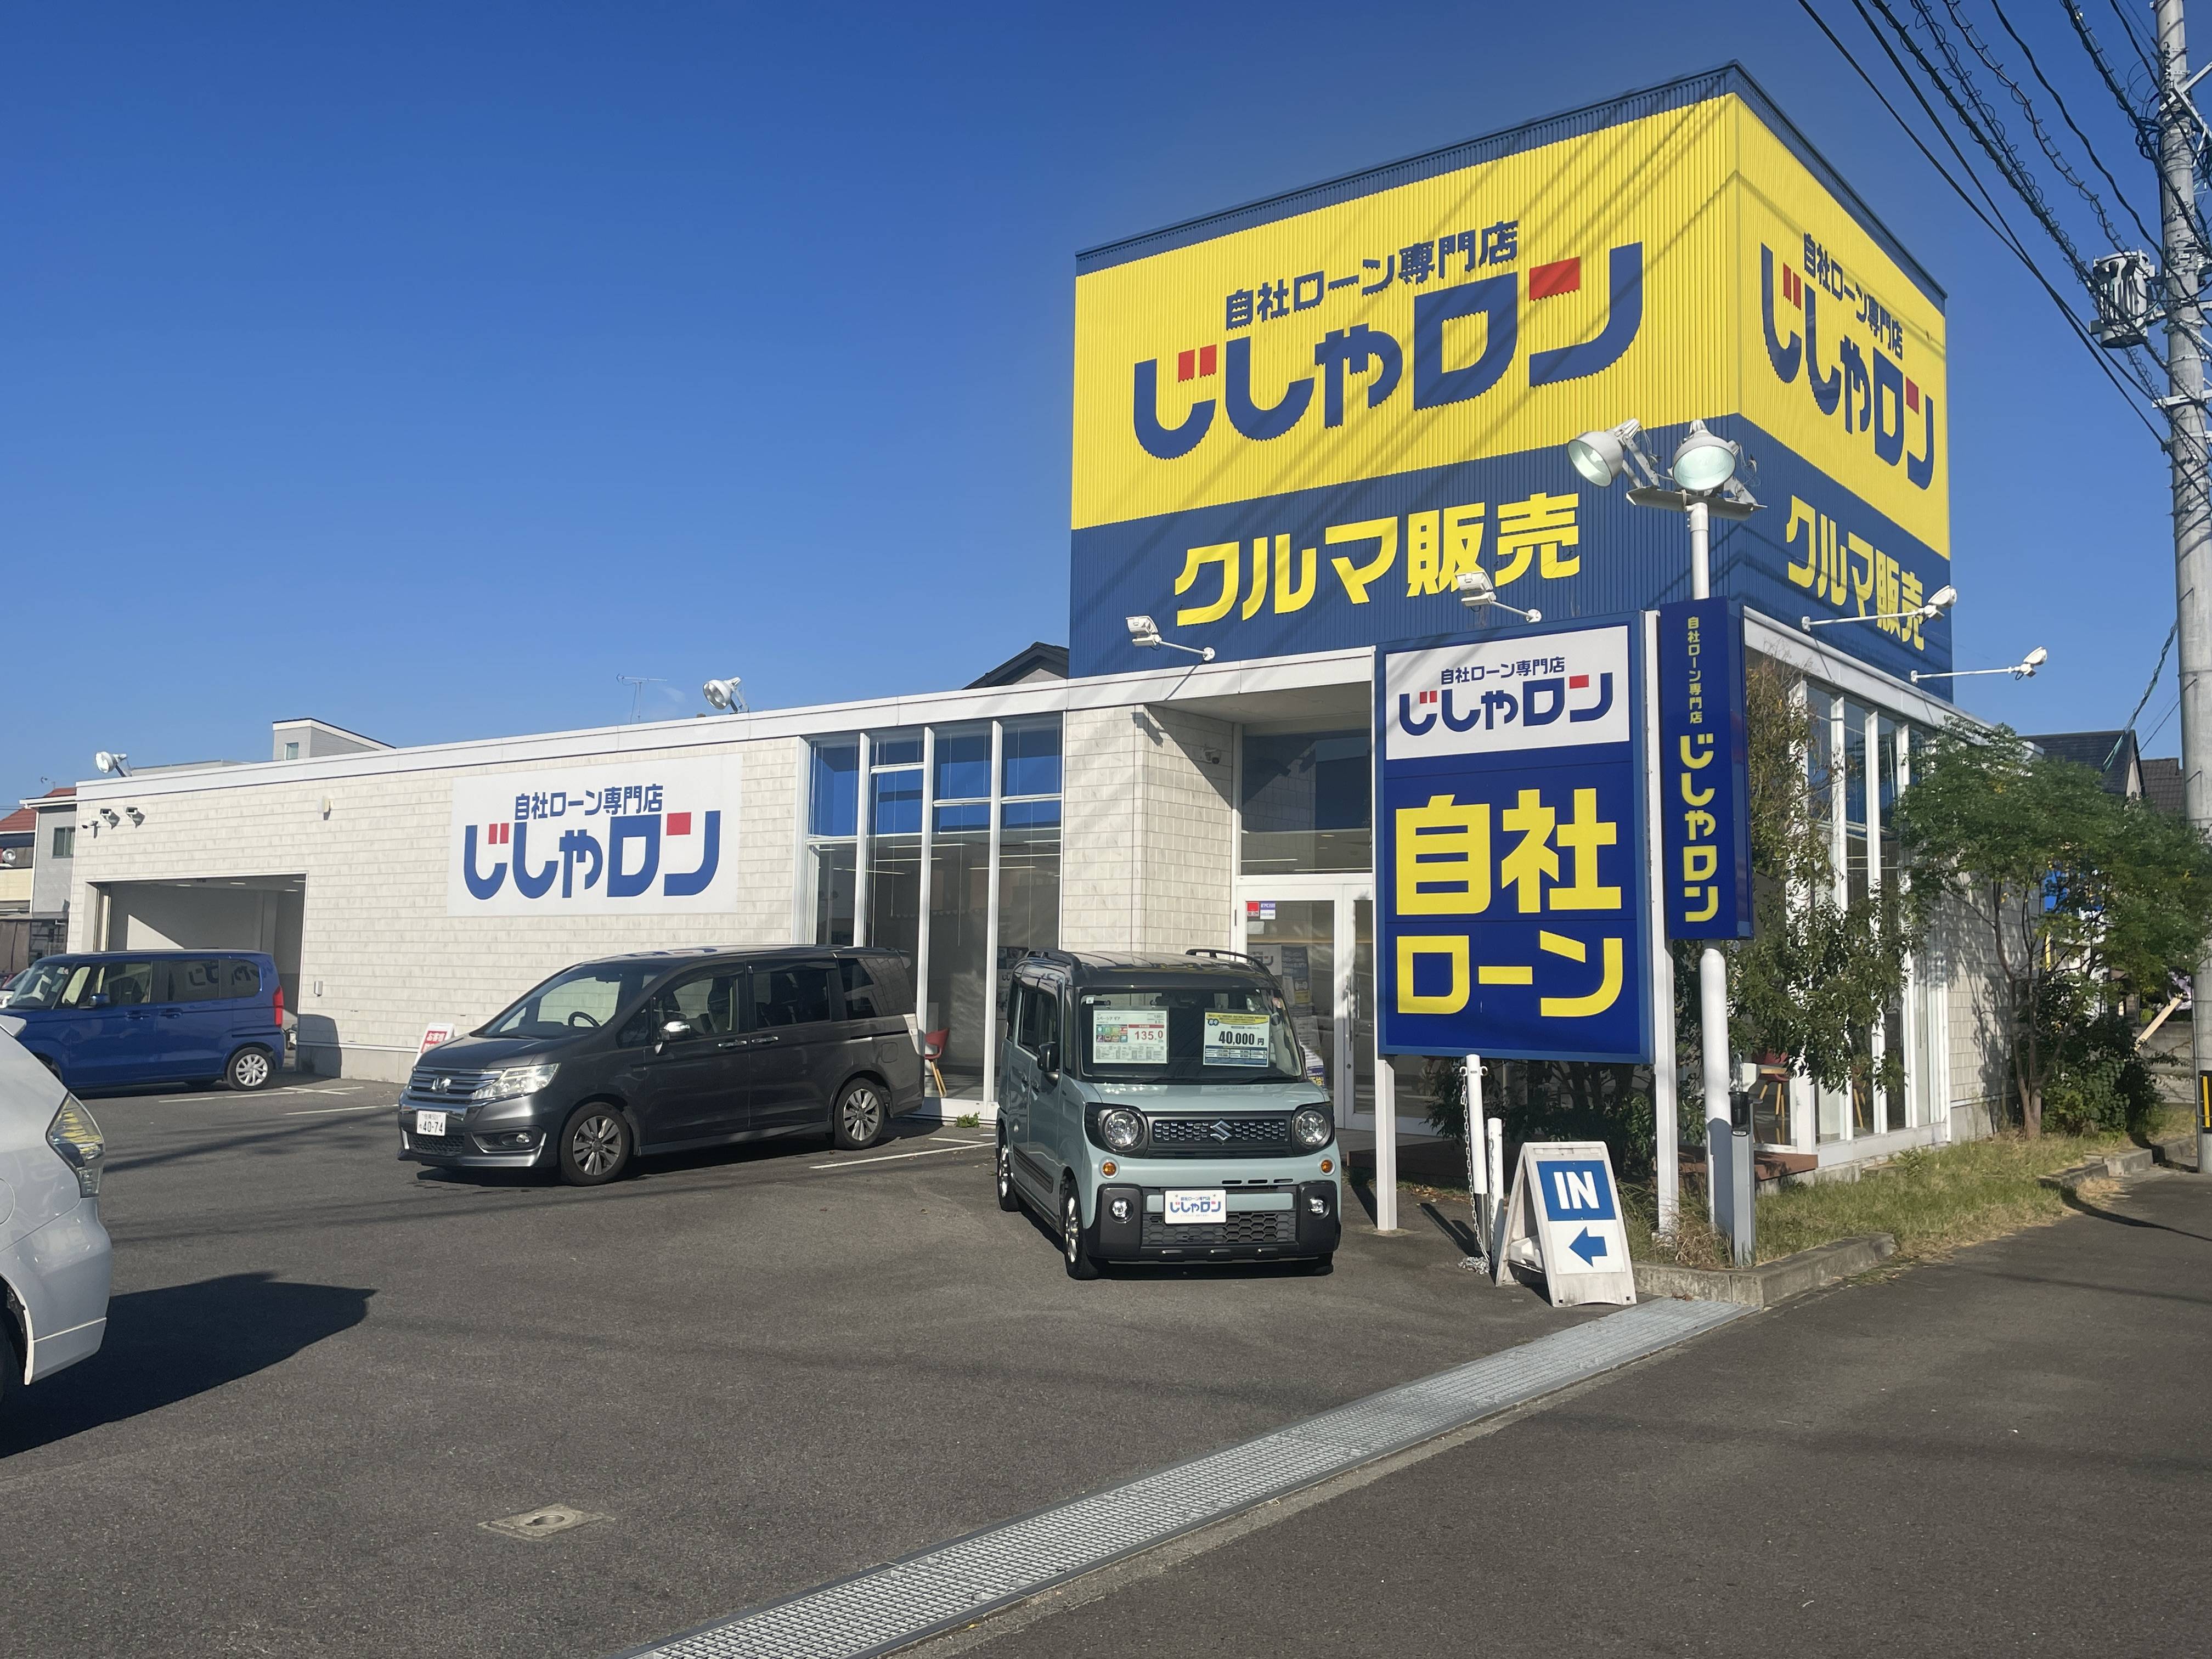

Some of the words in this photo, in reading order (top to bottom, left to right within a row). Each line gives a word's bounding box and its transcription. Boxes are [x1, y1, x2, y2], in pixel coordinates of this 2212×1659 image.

[1226, 221, 1518, 330] 自社ローン専門店
[1803, 233, 1903, 360] 自社ローン専門店
[1133, 241, 1643, 460] じしゃロン
[1761, 242, 1934, 490] じしゃロン
[1175, 493, 1579, 626] クルマ販売
[1786, 494, 1925, 651] クルマ販売
[1399, 672, 1613, 736] じしゃロン
[1441, 656, 1565, 685] 自社ローン専門店
[1687, 616, 1702, 724] 自社ローン専門店
[464, 810, 721, 900] じしゃロン
[515, 784, 663, 820] 自社ローン専門店
[1396, 788, 1621, 915] 自社
[1680, 733, 1718, 922] じしゃロン
[1397, 930, 1623, 1017] ローン
[1218, 1031, 1255, 1045] 40,000
[1554, 1171, 1600, 1209] IN
